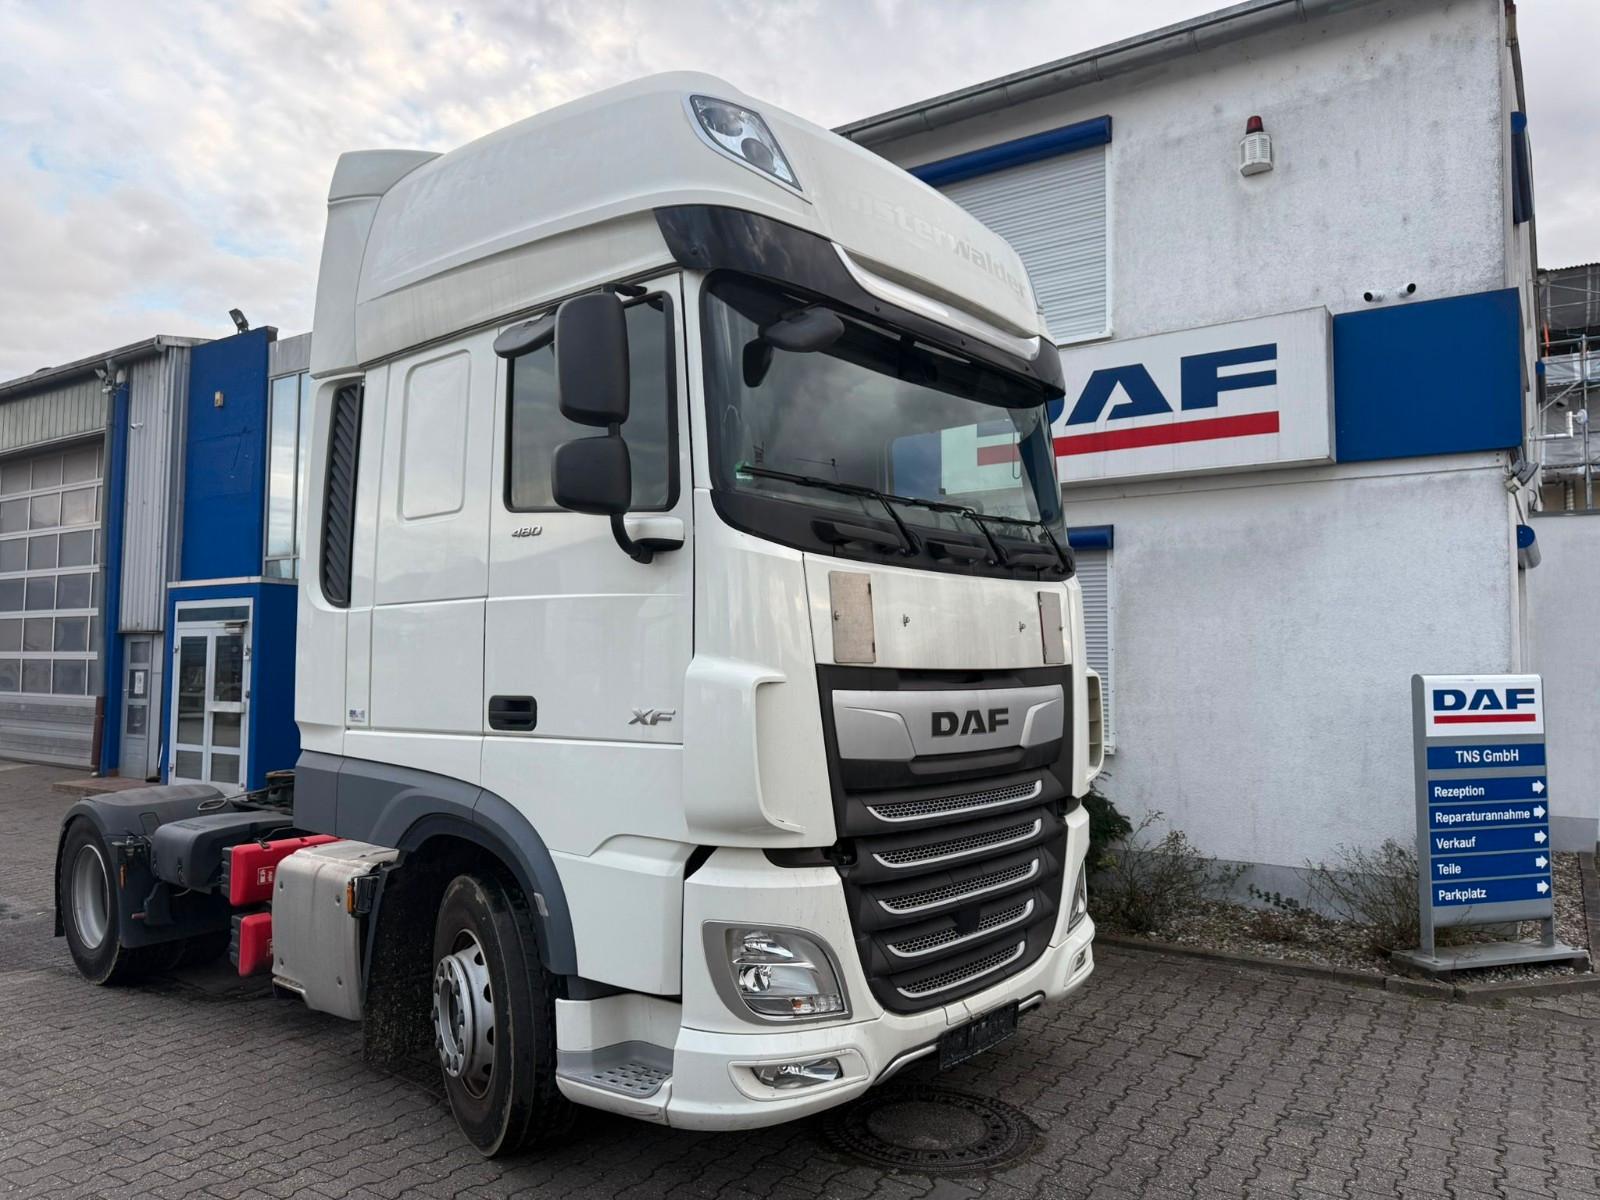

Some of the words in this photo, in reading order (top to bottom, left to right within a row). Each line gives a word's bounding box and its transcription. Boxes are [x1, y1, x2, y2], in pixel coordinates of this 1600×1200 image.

[1049, 342, 1277, 426] AF
[512, 526, 543, 537] 480
[1433, 688, 1535, 711] DAF
[628, 709, 676, 725] XF
[931, 708, 1009, 737] DAF
[1455, 750, 1480, 764] TNS
[1483, 748, 1519, 763] GmbH
[1434, 785, 1485, 799] Rezeption
[1435, 809, 1530, 824] Reparaturannahme
[1436, 836, 1476, 849] Verkauf
[1437, 863, 1462, 875] Teile
[1438, 888, 1487, 902] Parkplatz
